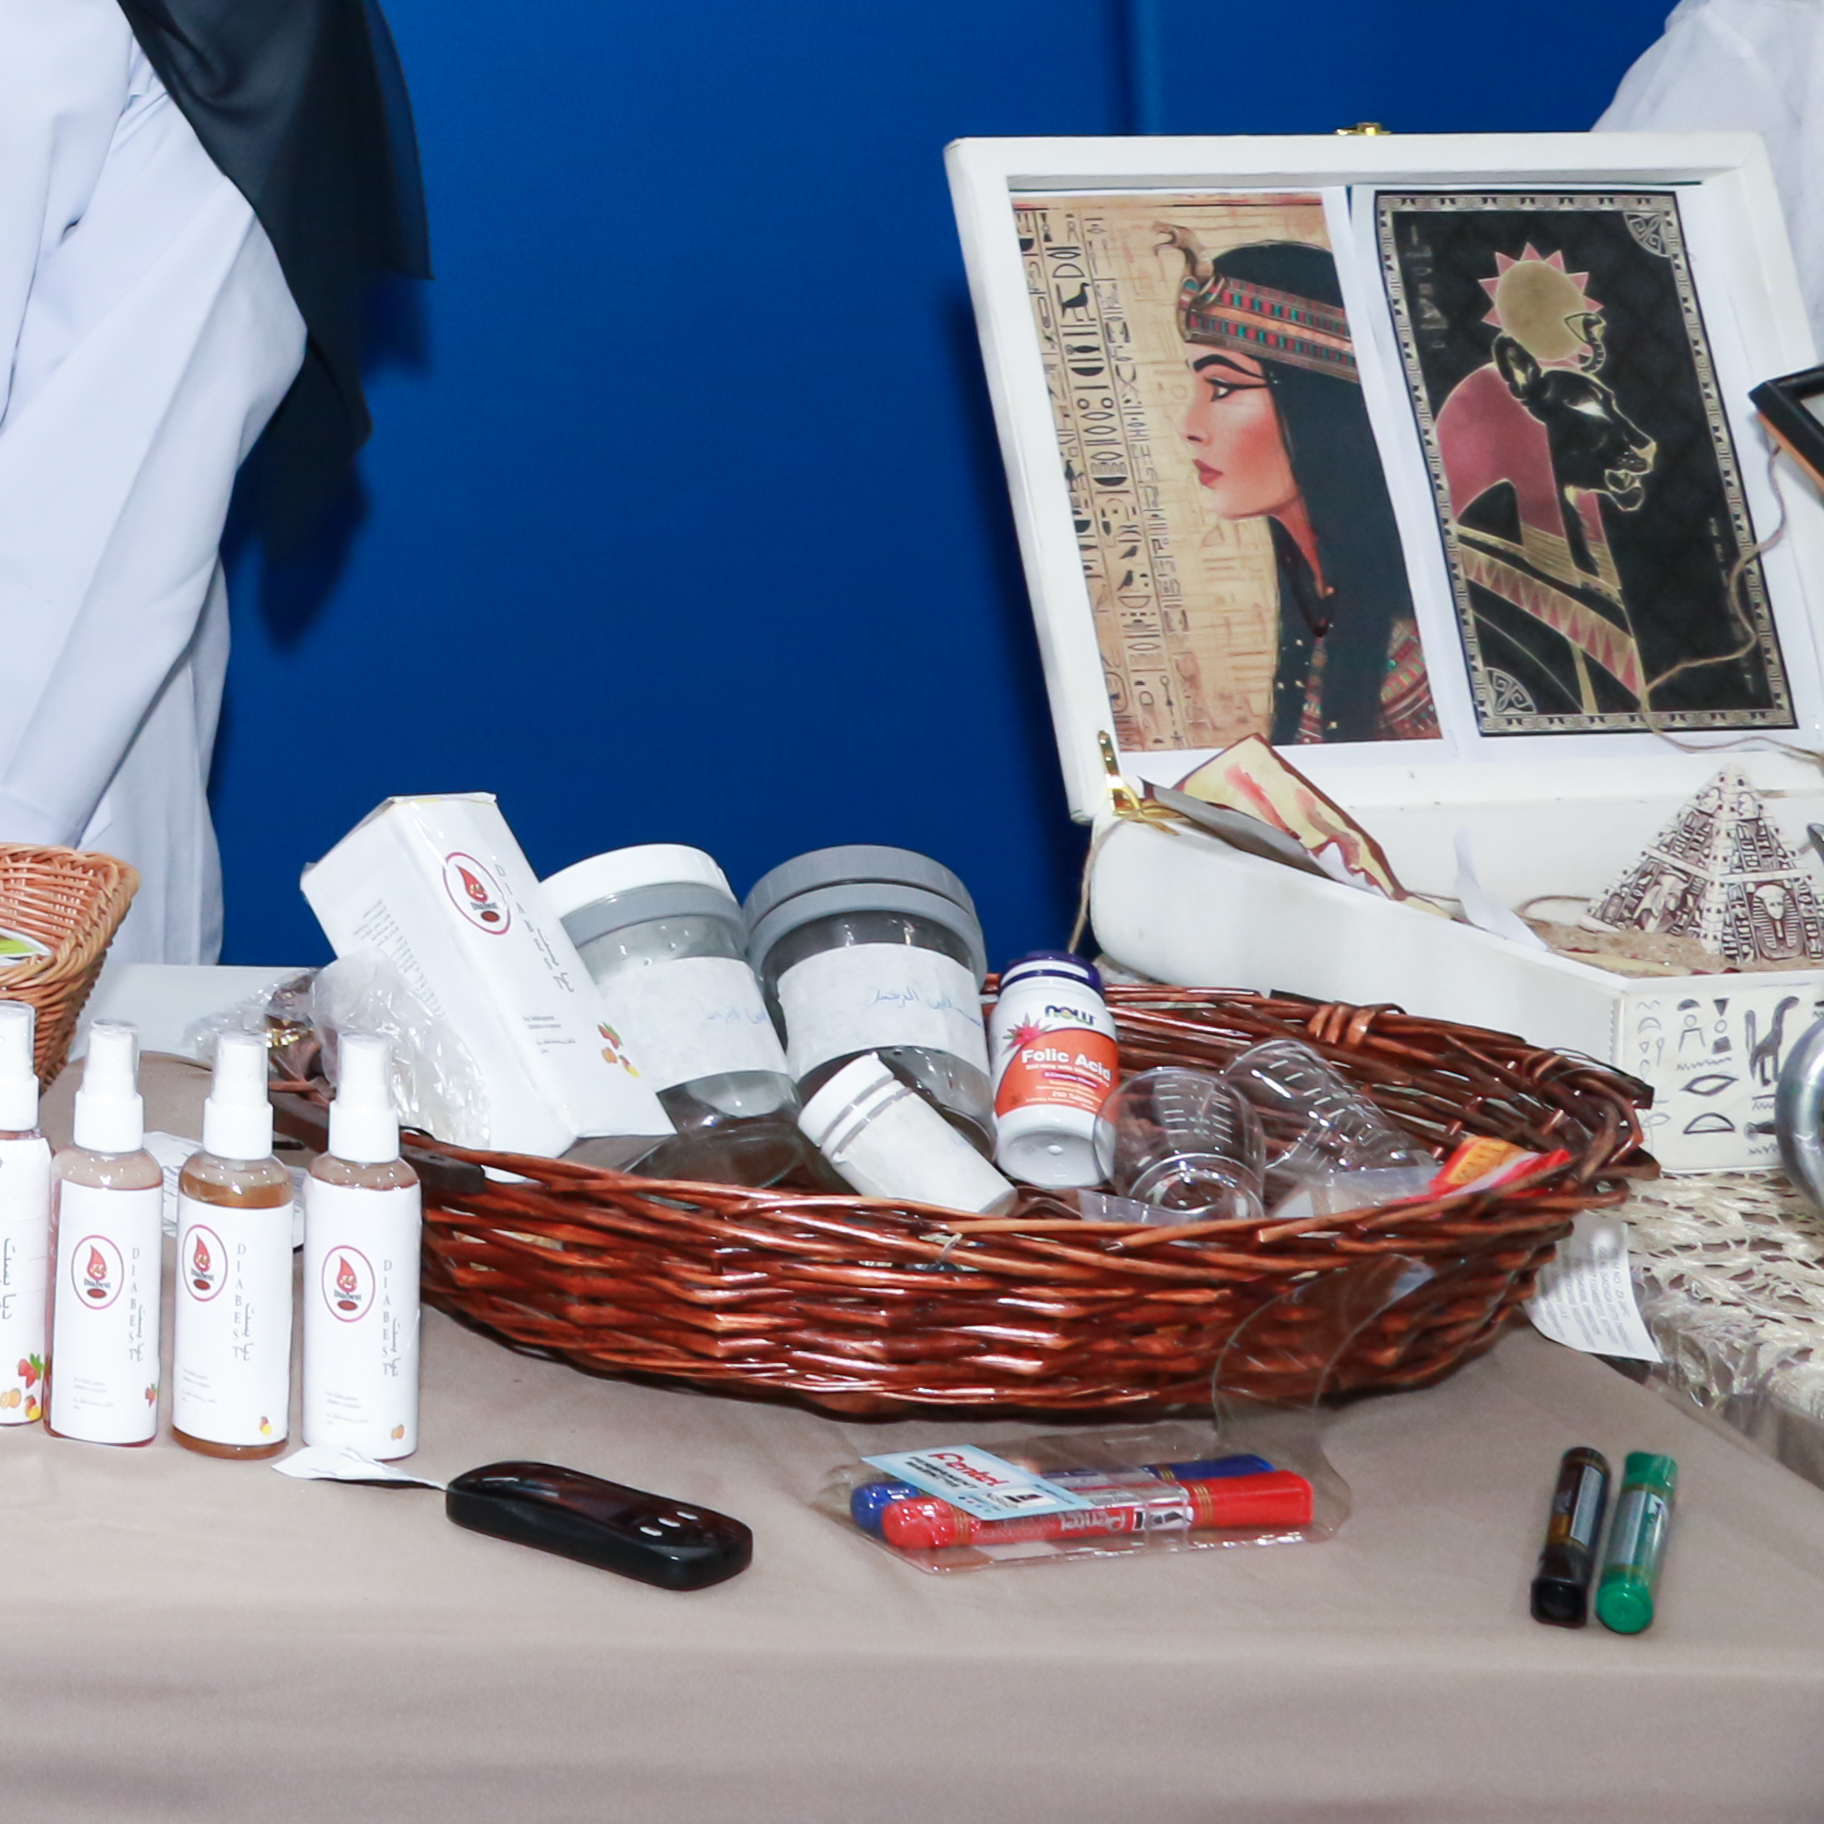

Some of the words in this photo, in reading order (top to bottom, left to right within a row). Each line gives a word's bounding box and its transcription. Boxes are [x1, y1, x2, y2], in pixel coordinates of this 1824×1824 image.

[1021, 1048, 1070, 1063] Folic
[1075, 1053, 1112, 1081] Acid
[928, 1452, 1009, 1488] Pentel
